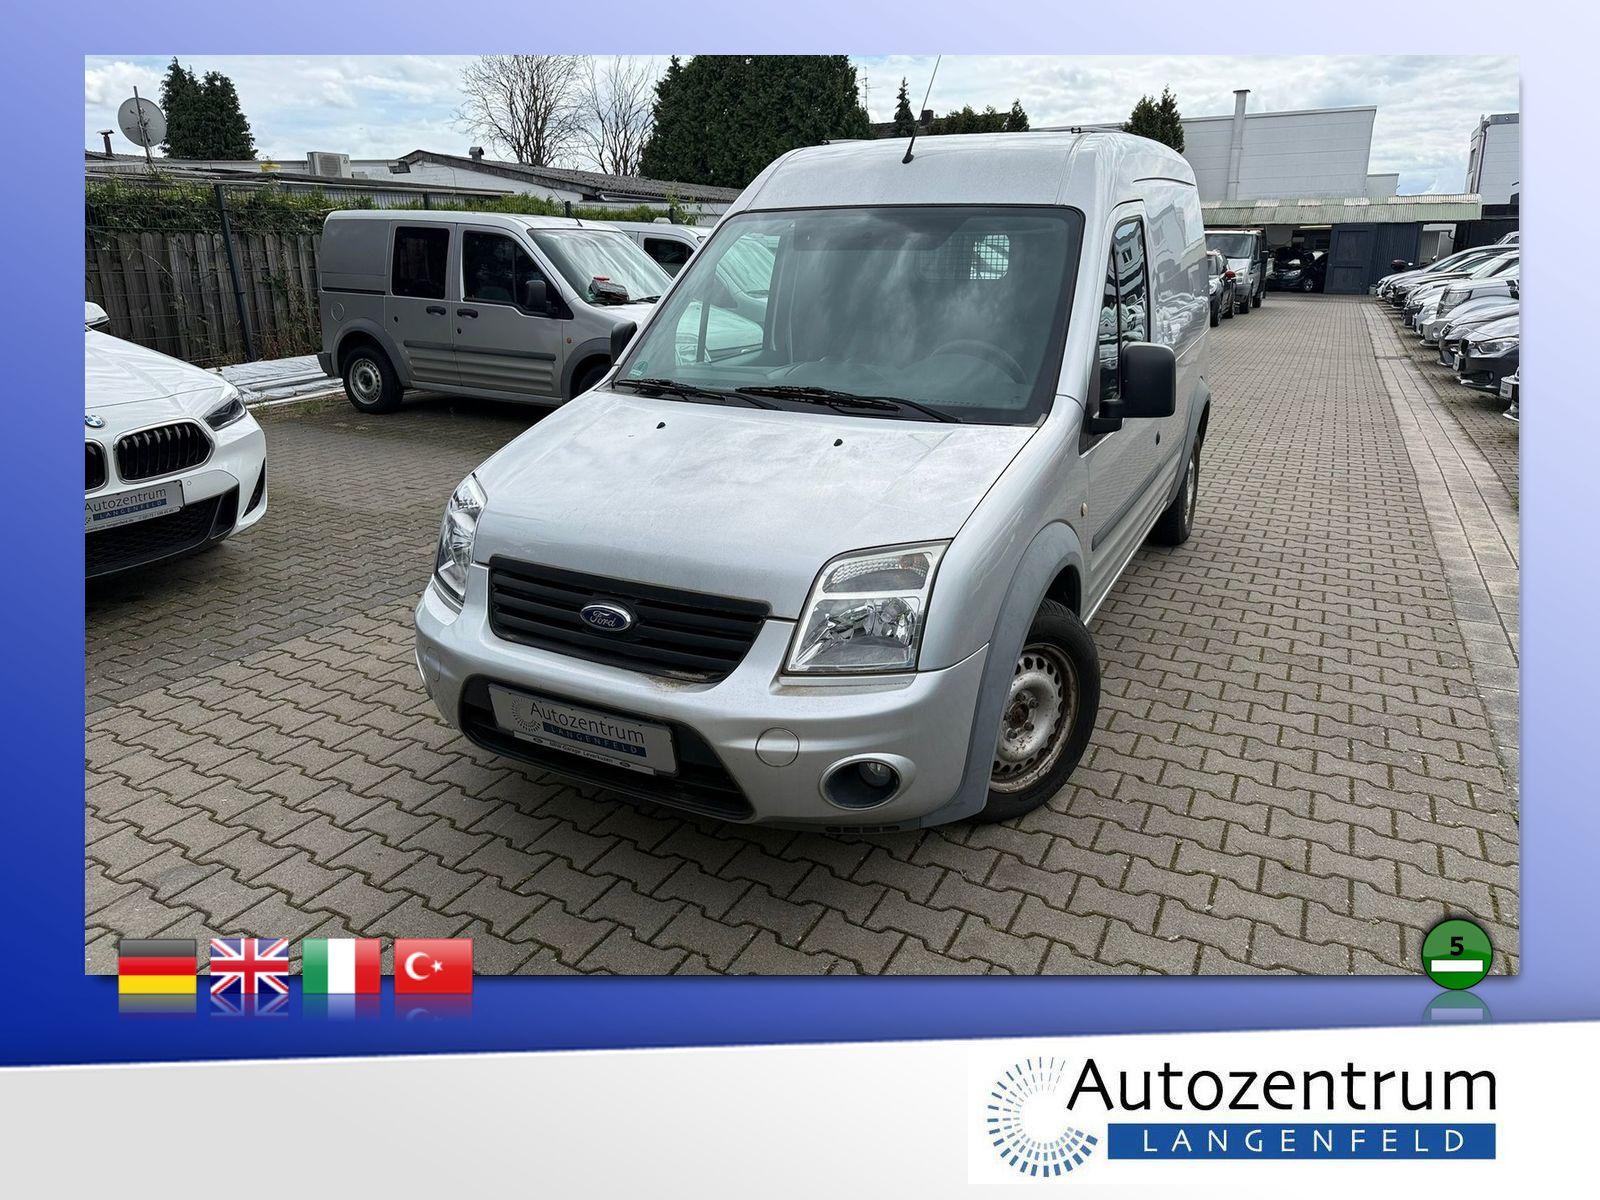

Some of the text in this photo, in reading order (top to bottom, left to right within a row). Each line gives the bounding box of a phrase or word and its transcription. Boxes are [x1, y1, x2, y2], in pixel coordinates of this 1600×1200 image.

[85, 488, 167, 513] Autozentrum
[99, 500, 163, 519] LANGENFELD
[590, 610, 617, 627] Ford
[530, 702, 645, 744] Autozentrum
[550, 723, 638, 754] LANGENFELD
